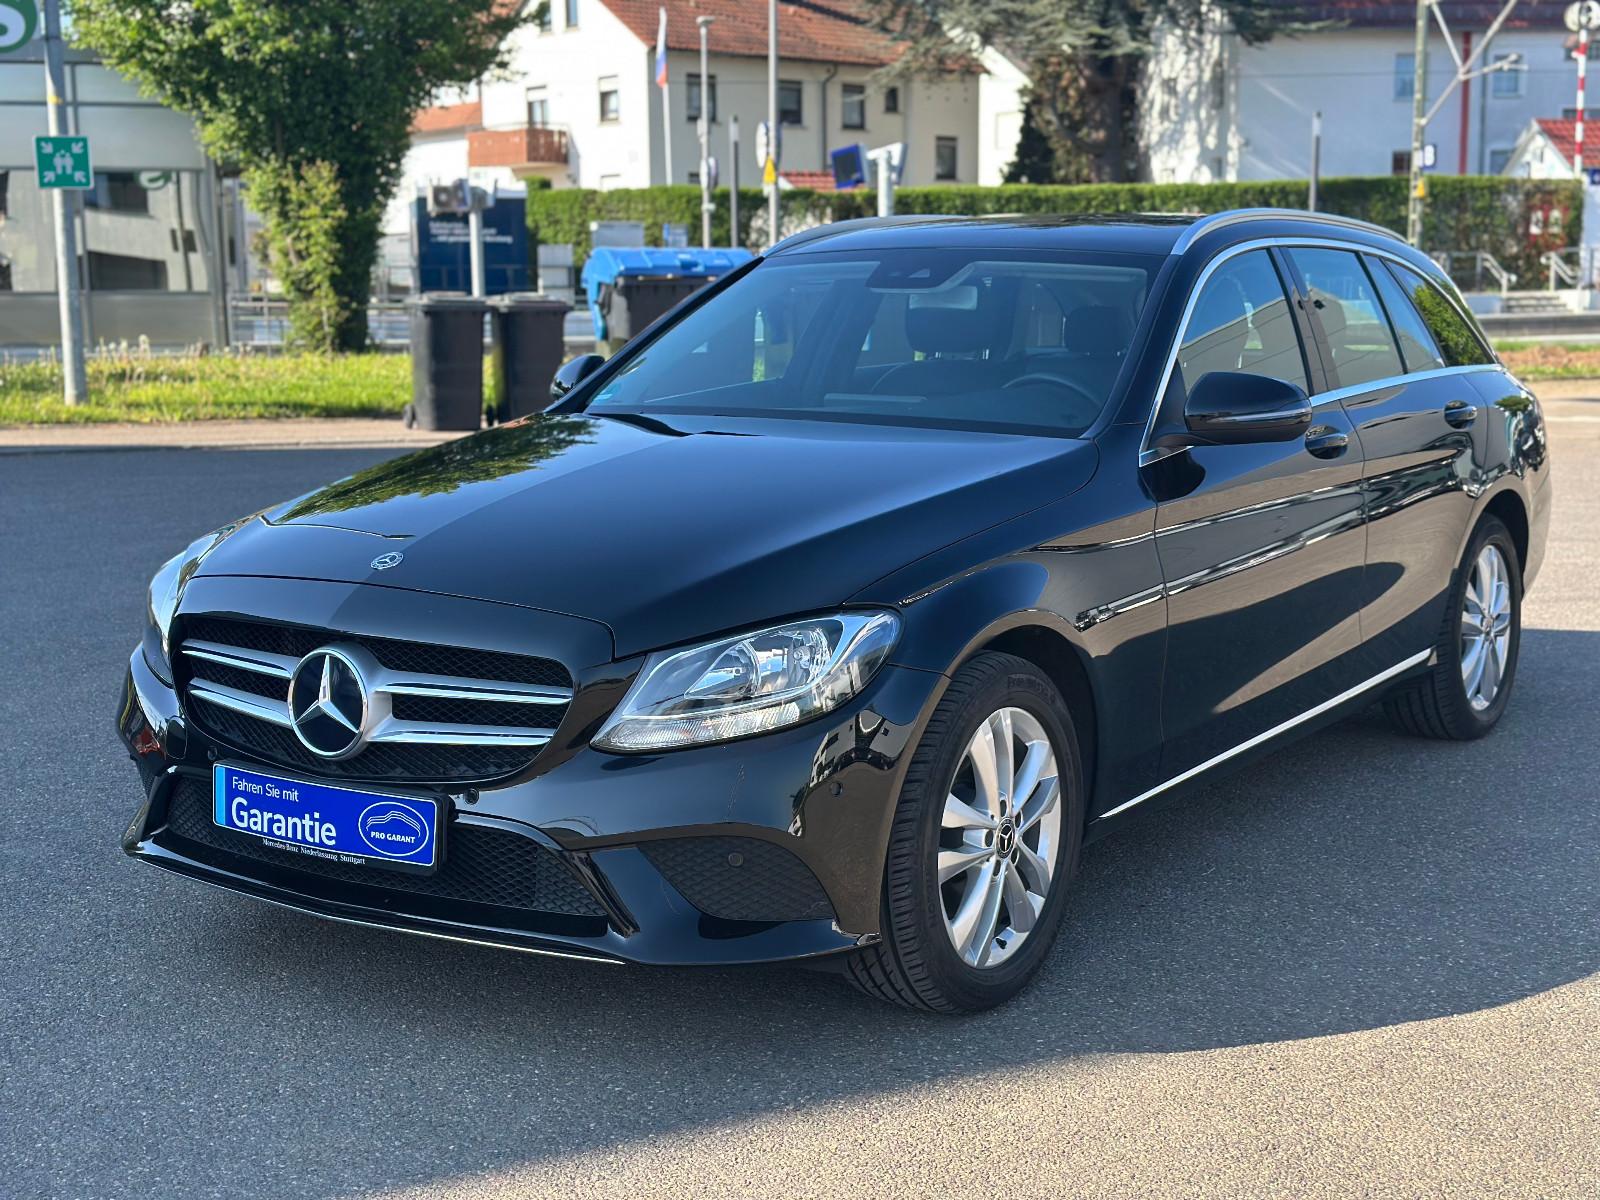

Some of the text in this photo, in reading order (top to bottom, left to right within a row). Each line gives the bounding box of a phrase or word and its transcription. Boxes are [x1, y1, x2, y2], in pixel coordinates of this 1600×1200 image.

[232, 776, 299, 802] Fahren Sie mit
[231, 796, 337, 846] Garantie
[370, 831, 416, 844] PRO GARANT
[300, 846, 338, 862] Niederlassung
[339, 855, 366, 865] Stuttgart
